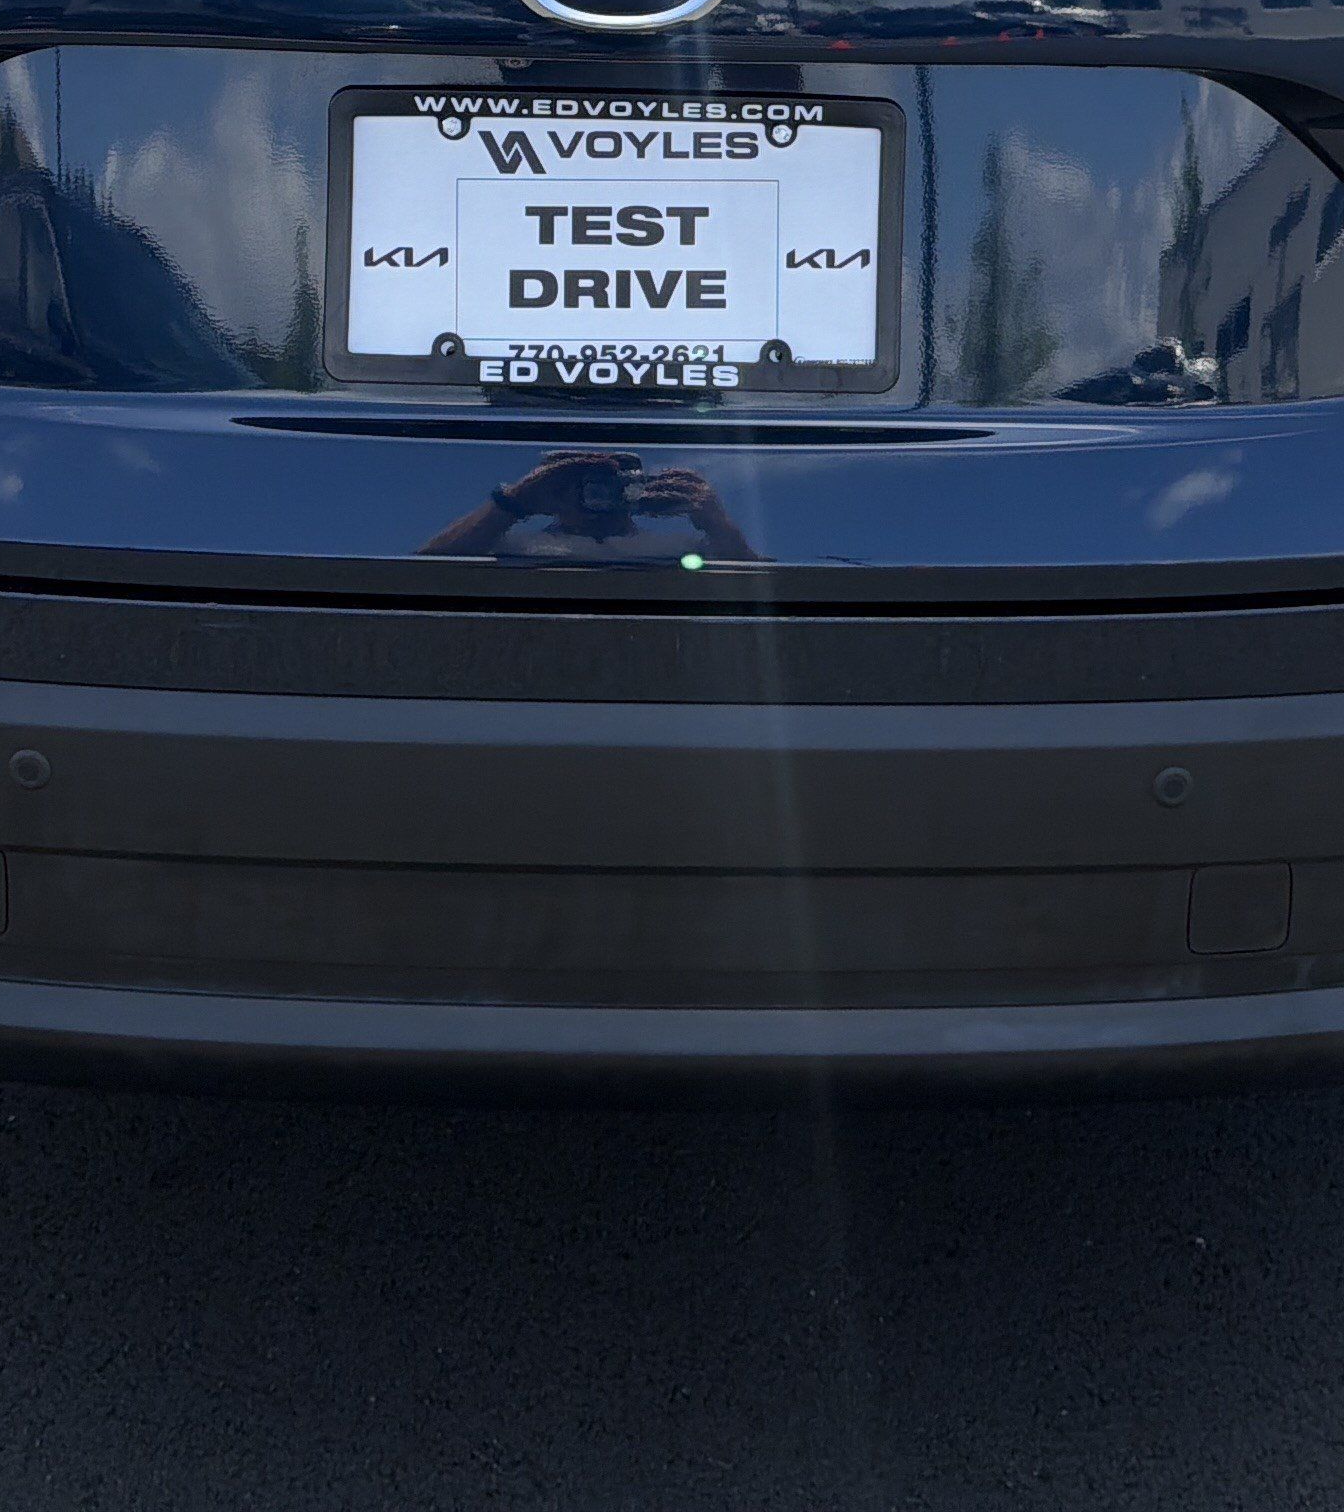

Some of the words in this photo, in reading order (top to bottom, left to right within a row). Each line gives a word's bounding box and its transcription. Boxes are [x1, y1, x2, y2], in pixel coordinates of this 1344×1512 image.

[414, 95, 824, 121] WWW.EDVOYLES.COM
[547, 130, 760, 160] VOYLES
[525, 205, 710, 246] TEST
[508, 269, 727, 309] DRIVE
[508, 344, 725, 363] 770-952-2621
[479, 360, 539, 384] ED
[556, 362, 739, 387] VOYLES
